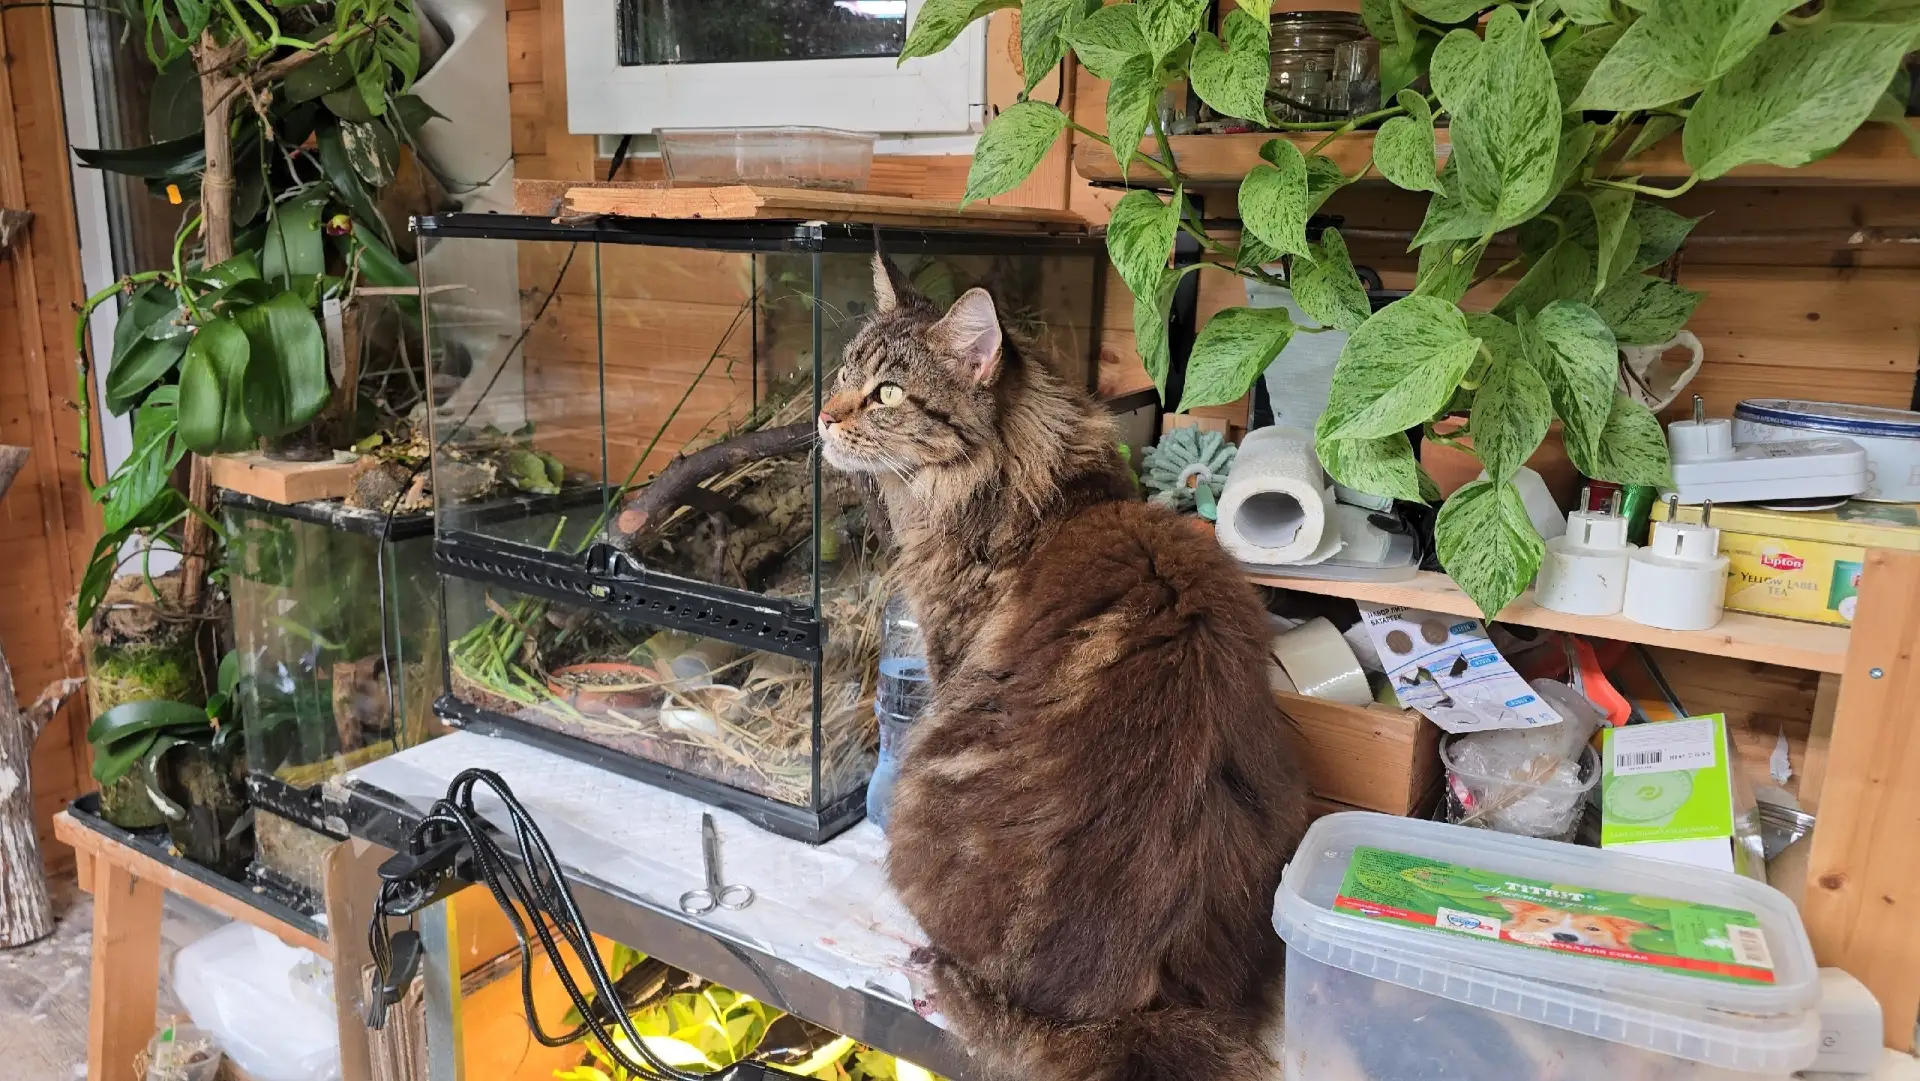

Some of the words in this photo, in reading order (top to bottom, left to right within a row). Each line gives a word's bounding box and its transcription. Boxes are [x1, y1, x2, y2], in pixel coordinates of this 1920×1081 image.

[1764, 554, 1801, 568] Lipton
[1741, 571, 1783, 585] YELLOW
[1787, 579, 1819, 592] LABEL
[1768, 586, 1788, 597] TEA
